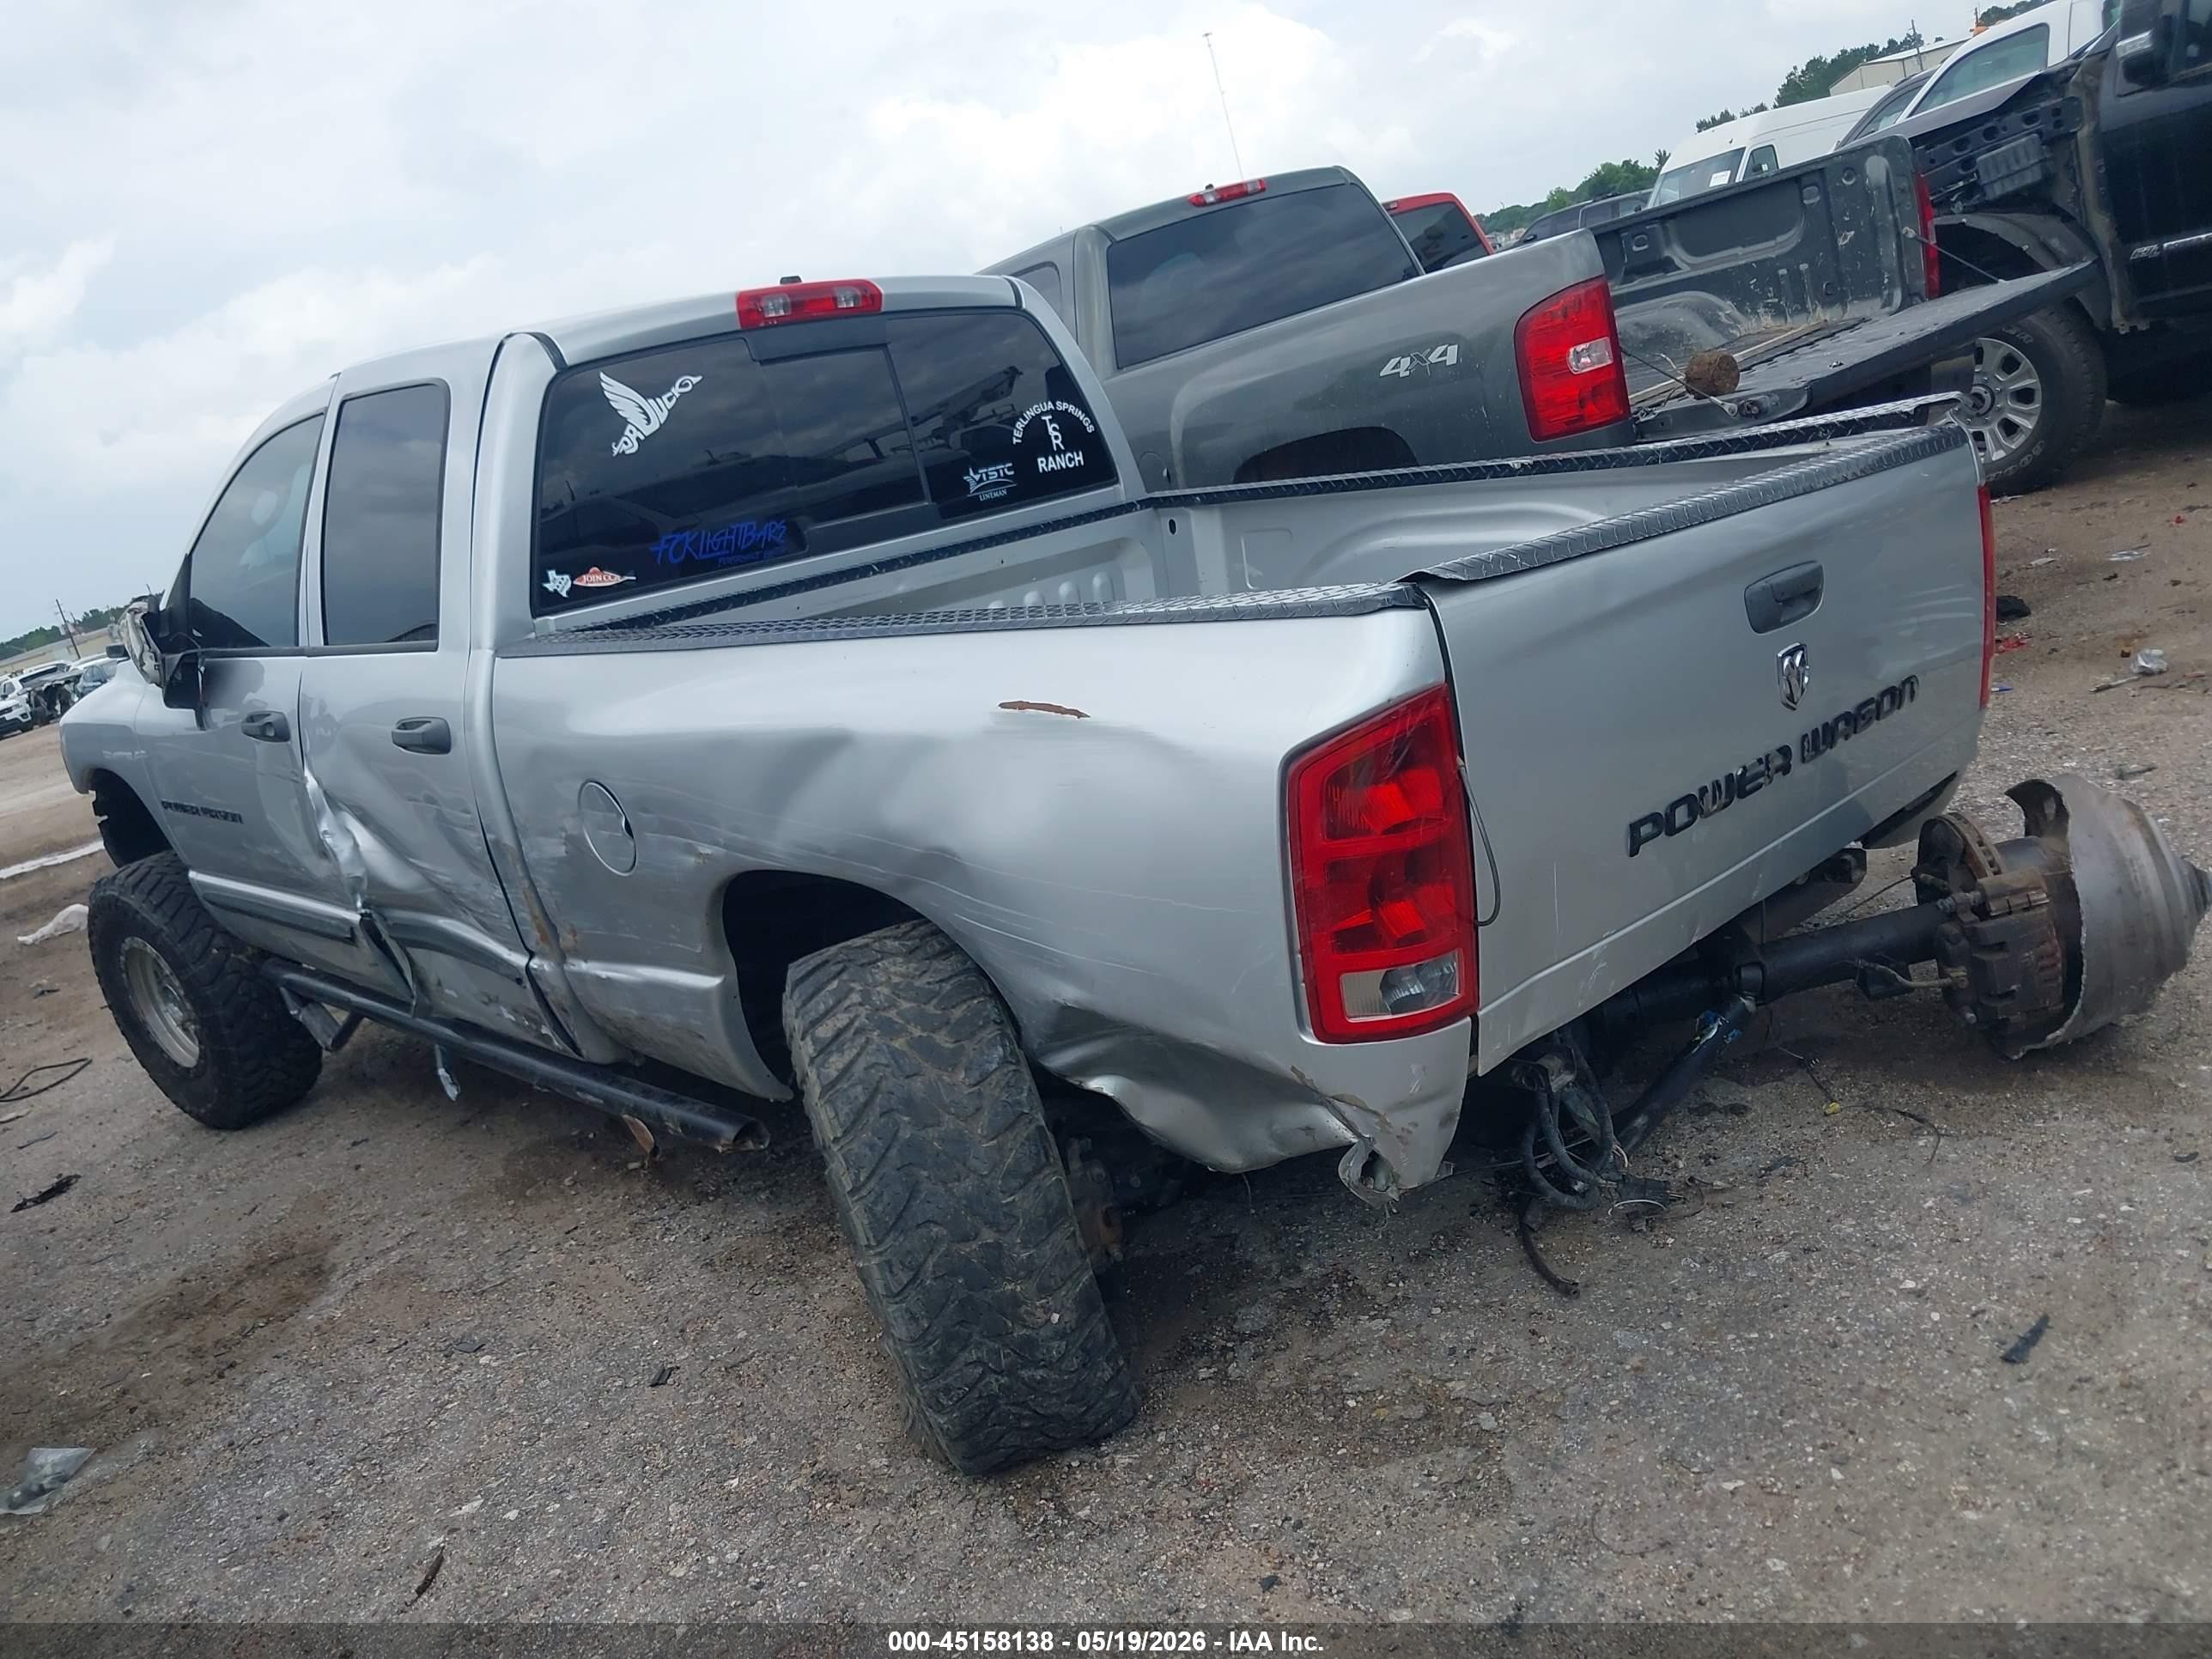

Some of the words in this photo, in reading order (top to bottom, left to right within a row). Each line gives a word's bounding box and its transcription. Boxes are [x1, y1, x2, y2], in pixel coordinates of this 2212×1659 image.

[1012, 401, 1054, 445] TERLINGUA
[1055, 401, 1095, 433] SPRINGS
[1037, 451, 1085, 473] RANCH
[978, 463, 1015, 482] TSTC
[979, 489, 1007, 501] LINEMAN
[583, 574, 603, 584] JOIN
[1626, 743, 1794, 858] POWER
[1800, 673, 1920, 764] WAGON
